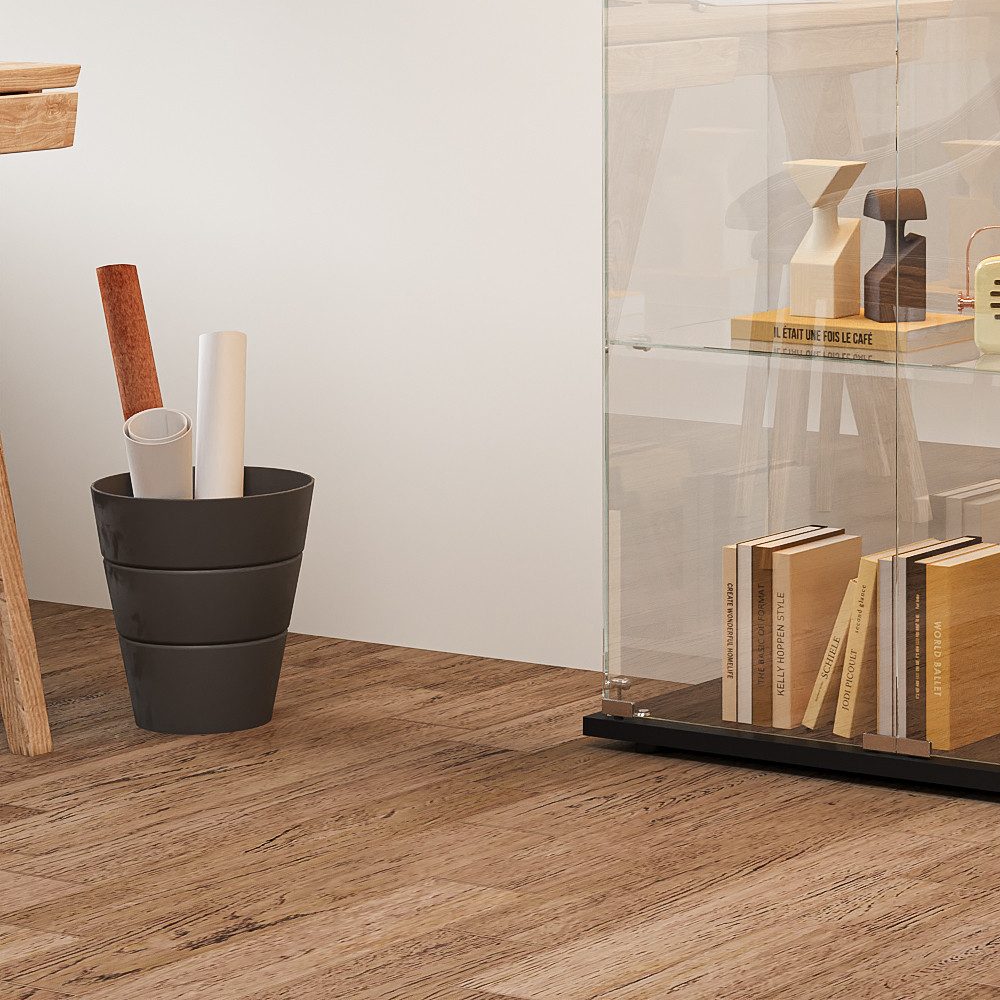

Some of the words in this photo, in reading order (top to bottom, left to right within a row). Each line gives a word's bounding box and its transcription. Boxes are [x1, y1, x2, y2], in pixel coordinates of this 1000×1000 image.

[773, 327, 781, 338] IL
[782, 325, 804, 340] ÉTAIT
[805, 328, 821, 341] UNE
[822, 330, 840, 343] FOIS
[841, 332, 851, 343] LE
[852, 331, 873, 345] CAFÉ
[726, 582, 734, 607] CREATE
[757, 584, 765, 621] FORMAT
[776, 592, 785, 621] STYLE
[858, 584, 867, 608] glance
[726, 608, 734, 647] WONDERFUL
[855, 609, 863, 633] second
[757, 639, 765, 664] BASIC
[776, 625, 785, 664] HOPPEN
[933, 621, 942, 658] WORLD
[726, 648, 734, 680] HOMELIFE
[821, 636, 841, 680] SCHIELE
[845, 648, 858, 689] PICOULT
[757, 667, 765, 685] THE
[776, 666, 785, 697] KELLY
[933, 662, 942, 697] BALLET
[842, 690, 851, 711] JODI
